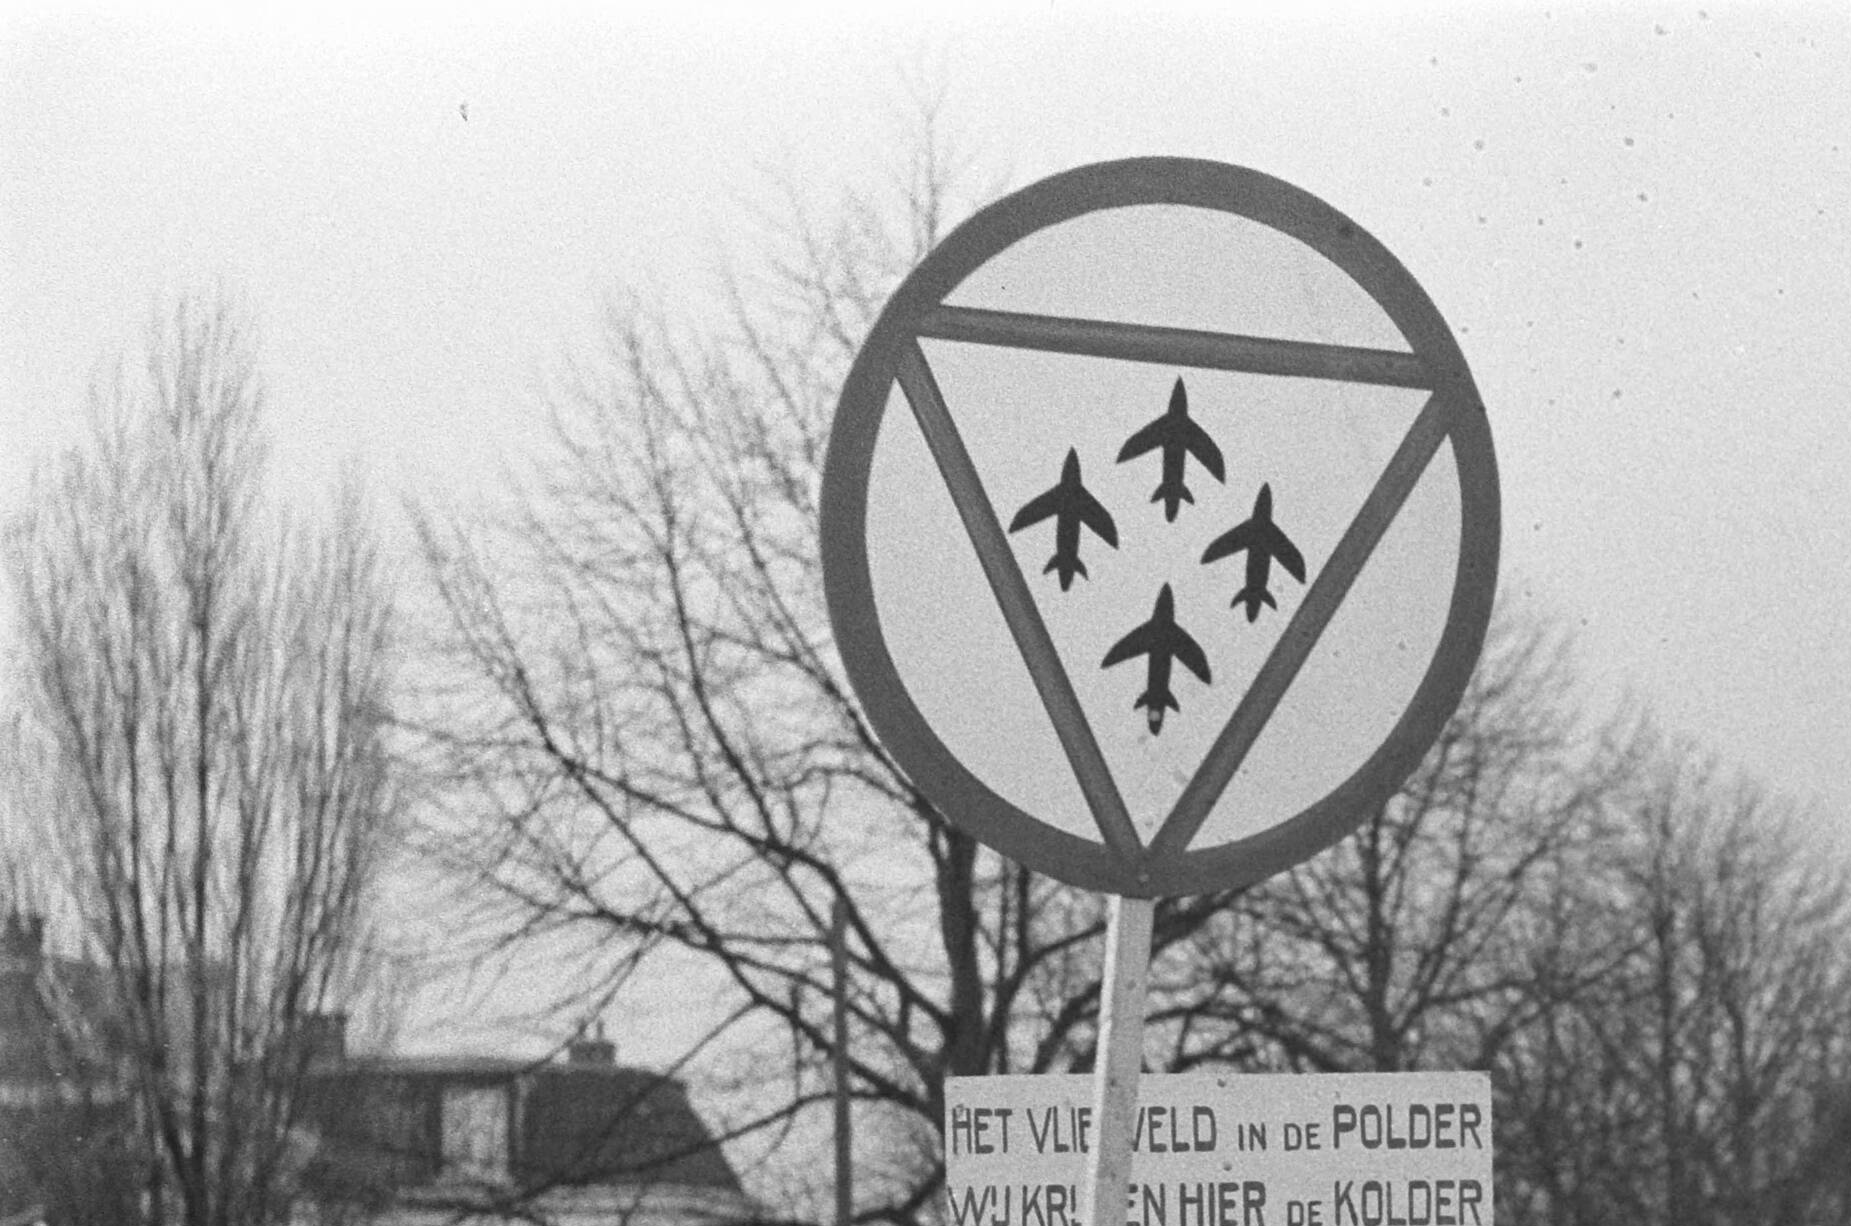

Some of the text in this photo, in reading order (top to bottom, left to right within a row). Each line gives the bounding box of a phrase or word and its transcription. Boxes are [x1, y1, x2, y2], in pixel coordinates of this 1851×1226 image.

[952, 1106, 1013, 1154] HET
[1238, 1122, 1267, 1151] IN
[1284, 1123, 1321, 1151] DE
[1333, 1103, 1483, 1150] POLDER
